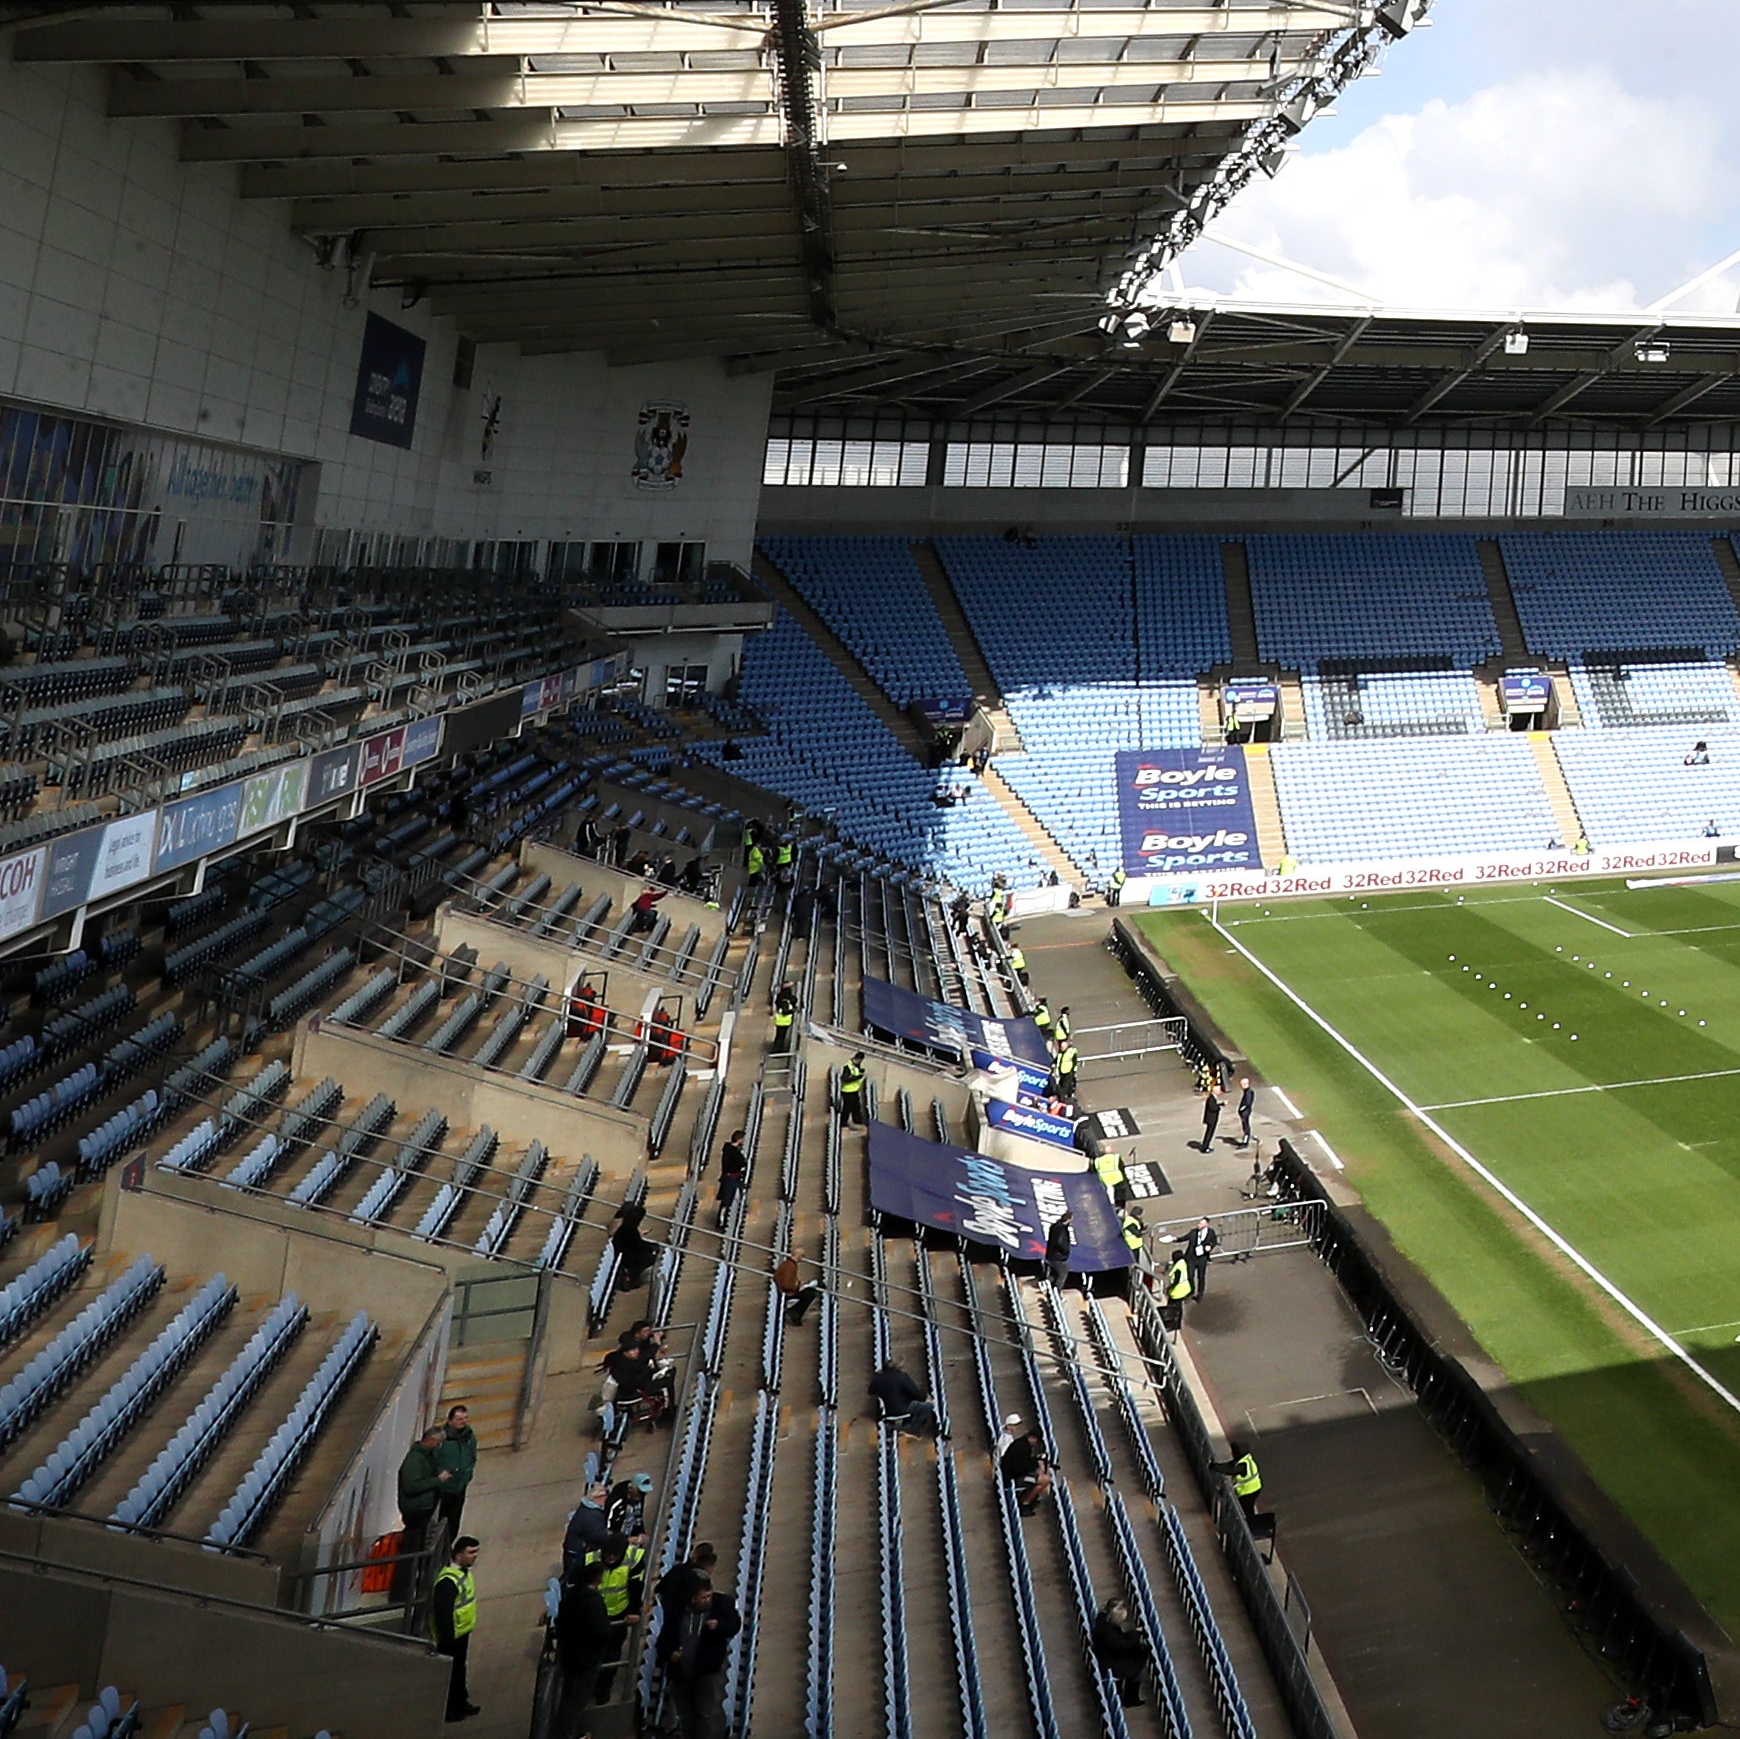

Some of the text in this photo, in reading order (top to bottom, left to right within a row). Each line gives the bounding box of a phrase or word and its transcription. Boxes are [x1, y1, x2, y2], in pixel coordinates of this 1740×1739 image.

[1622, 492, 1665, 511] THE
[1135, 765, 1237, 786] Boyle
[1139, 784, 1239, 802] Sports
[1141, 830, 1248, 853] Boyle
[1146, 851, 1249, 871] Sports
[1205, 850, 1711, 899] 32Red 32Red 32Red 32Red 32Red 32Red 32Red 32Red
[1002, 1108, 1071, 1139] BoyleSports
